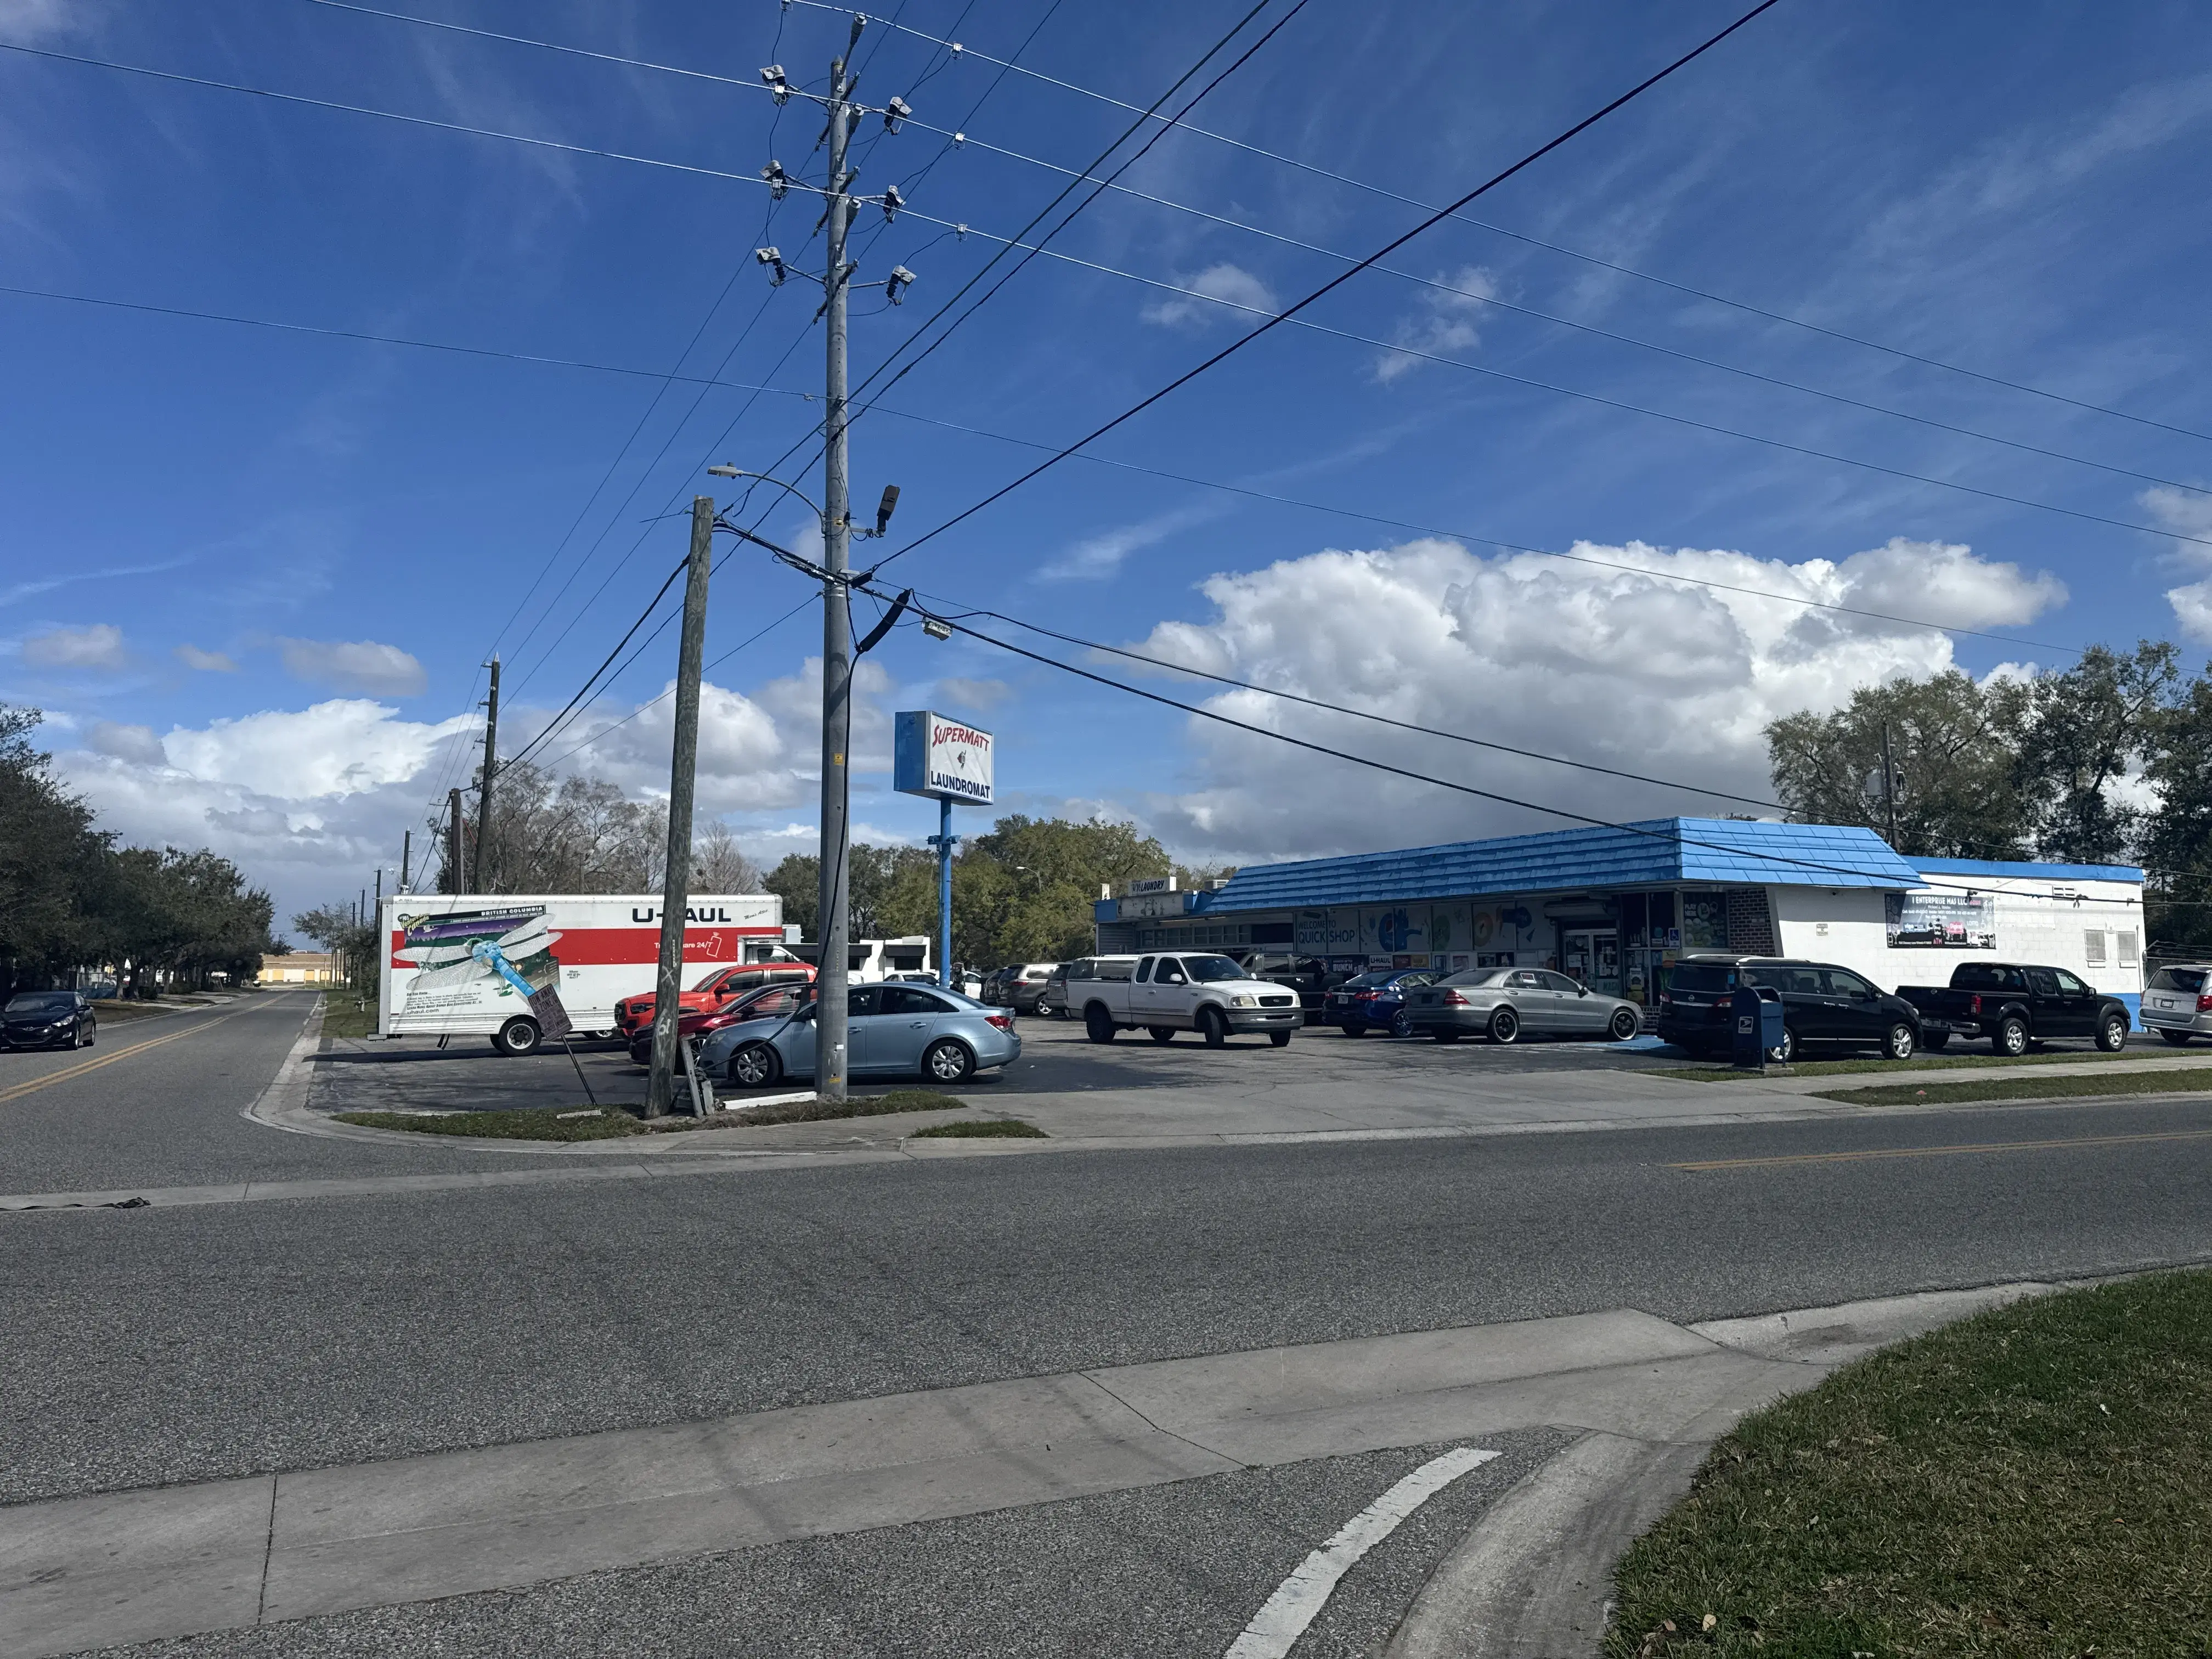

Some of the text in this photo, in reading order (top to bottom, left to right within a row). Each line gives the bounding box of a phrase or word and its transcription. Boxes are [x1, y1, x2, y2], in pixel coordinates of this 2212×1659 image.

[933, 725, 989, 751] SUPERMATT
[931, 771, 990, 798] LAUNDROMAT
[1141, 880, 1164, 892] LAUNDRY
[1916, 896, 1945, 905] ENTERPRISE
[1957, 897, 1967, 906] LLC
[633, 908, 731, 923] U-AUL
[408, 916, 429, 936] Canada
[1299, 920, 1336, 929] WELCOME TO
[1299, 929, 1355, 944] QUICK SHOP
[529, 987, 554, 1006] TOW AWAY
[539, 1000, 553, 1012] ZONE
